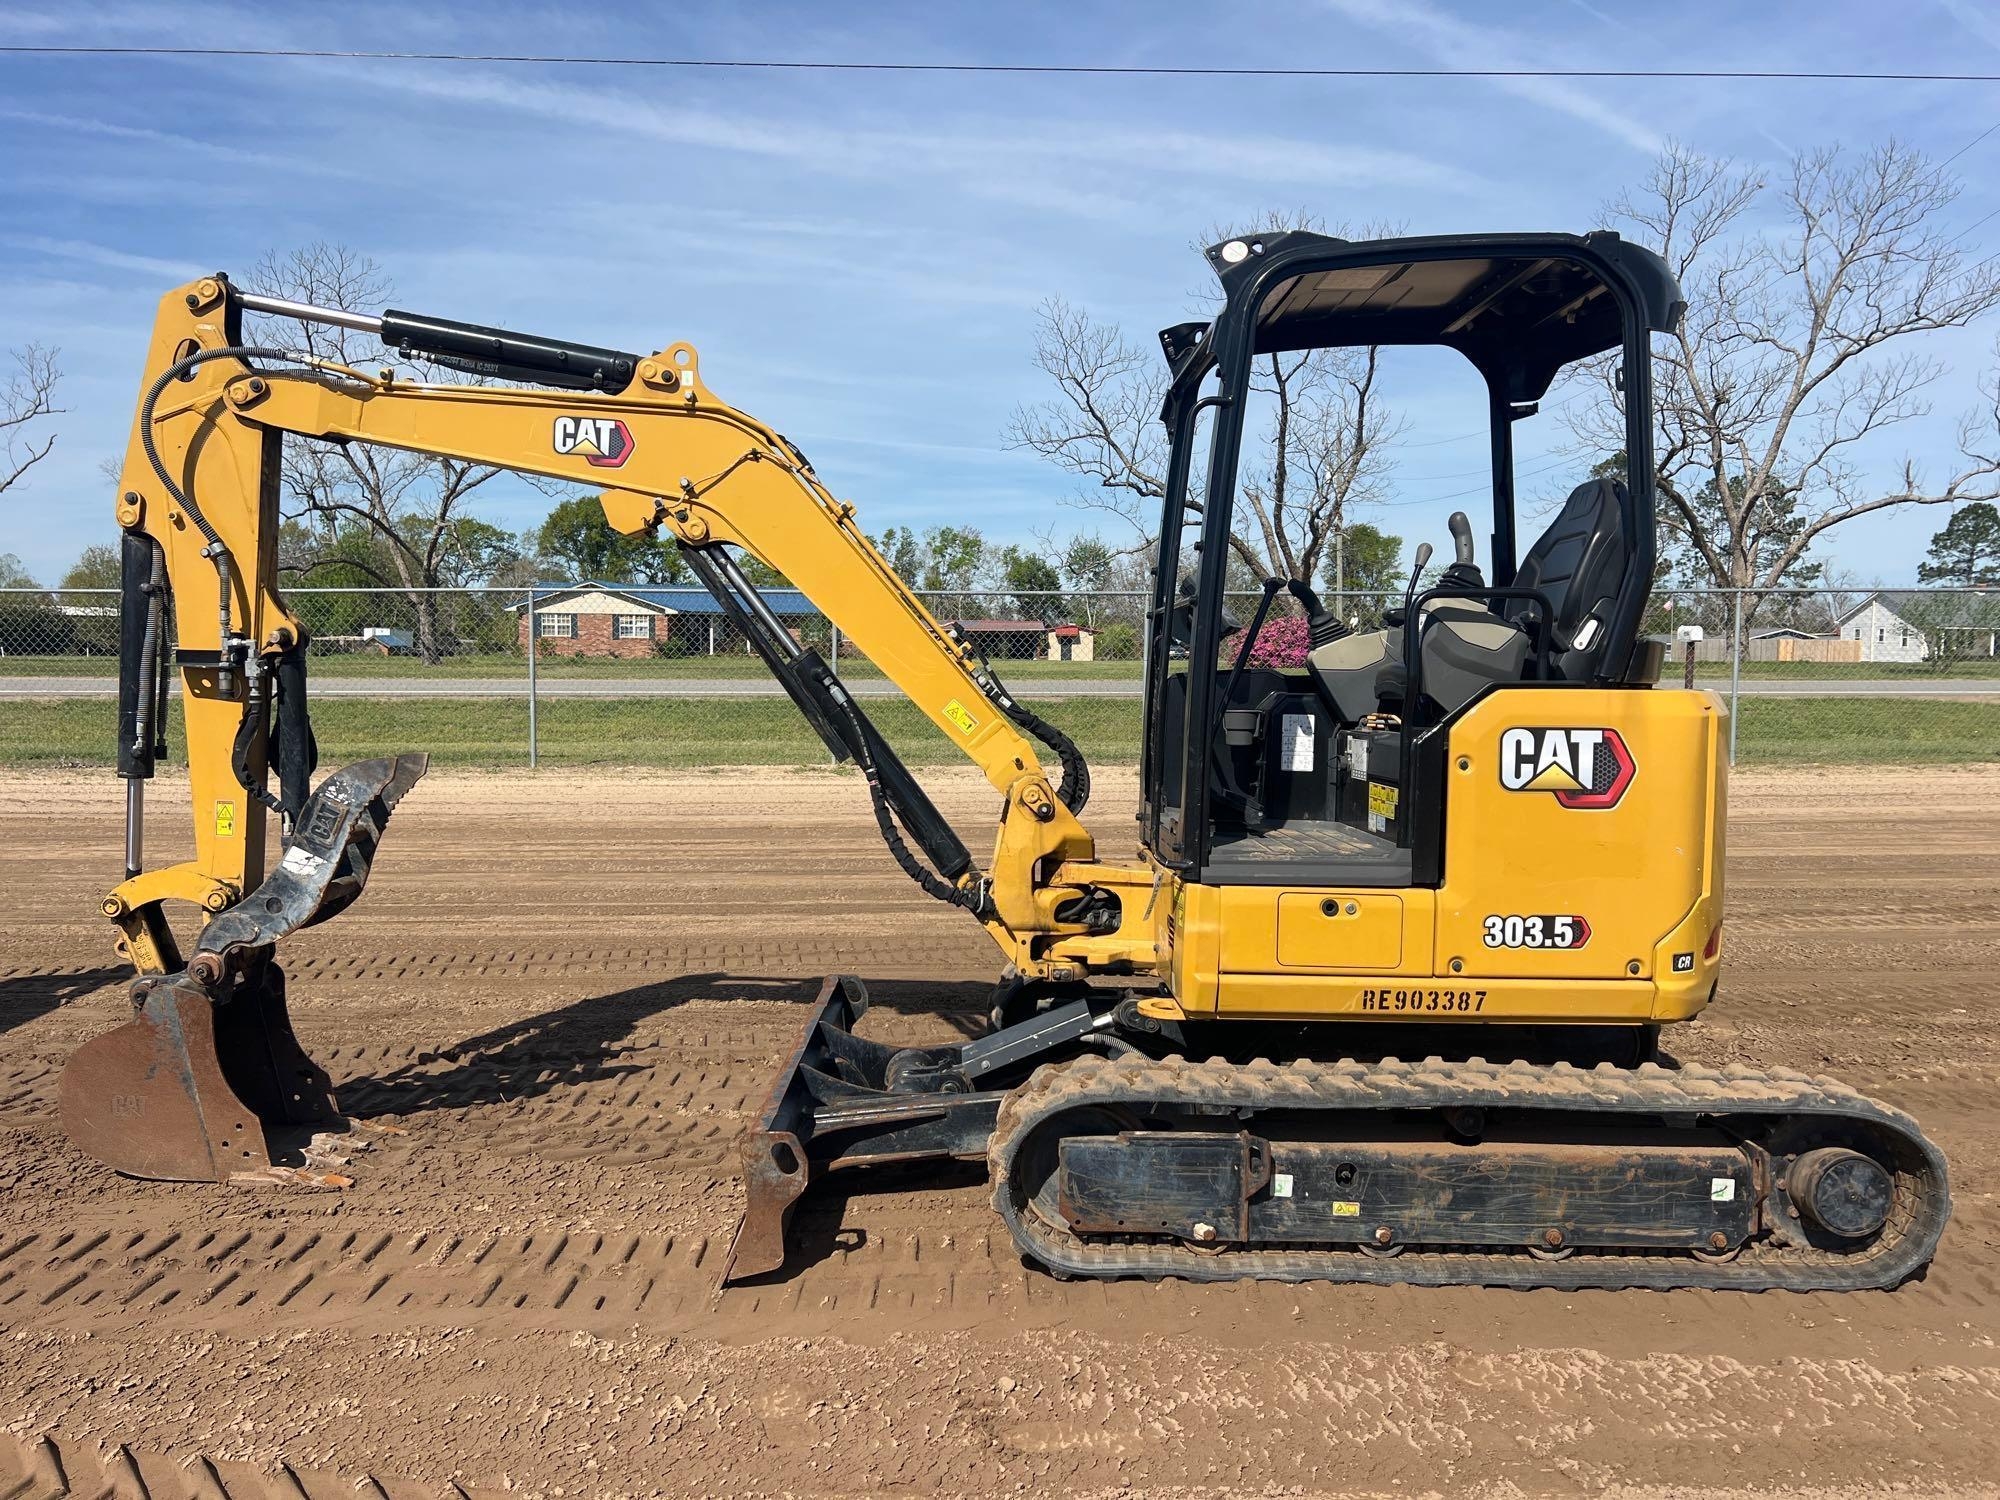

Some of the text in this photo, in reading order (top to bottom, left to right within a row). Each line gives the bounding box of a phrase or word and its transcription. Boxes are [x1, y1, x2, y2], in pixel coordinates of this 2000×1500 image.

[554, 416, 615, 456] CAT
[1501, 728, 1602, 790] CAT
[310, 802, 342, 840] CAT
[1484, 916, 1573, 947] 303.5
[1678, 955, 1692, 969] CR
[1362, 990, 1487, 1012] RE903387
[112, 1094, 148, 1118] CAT
